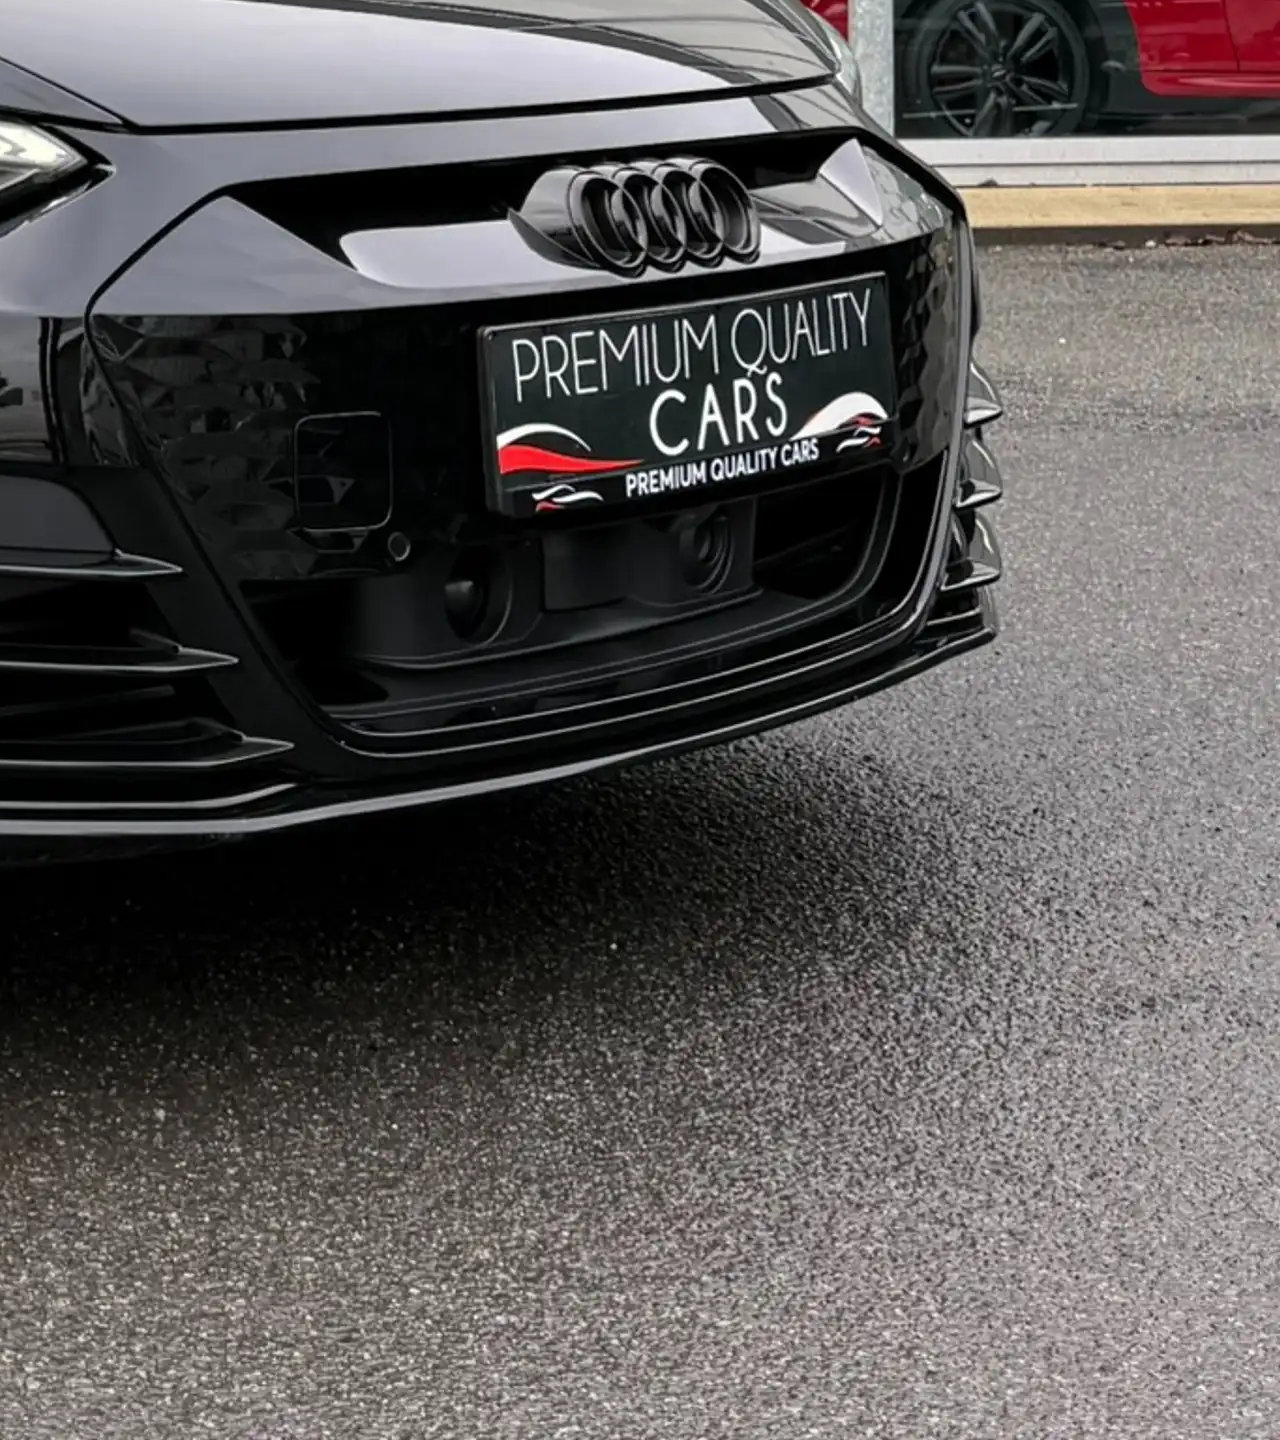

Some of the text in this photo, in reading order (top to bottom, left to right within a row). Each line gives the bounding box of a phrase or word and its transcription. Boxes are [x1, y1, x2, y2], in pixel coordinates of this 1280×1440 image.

[512, 288, 871, 403] PREMIUM QUALITY
[648, 372, 788, 456] CARS
[625, 438, 820, 498] PREMIUM QUALITY CARS
